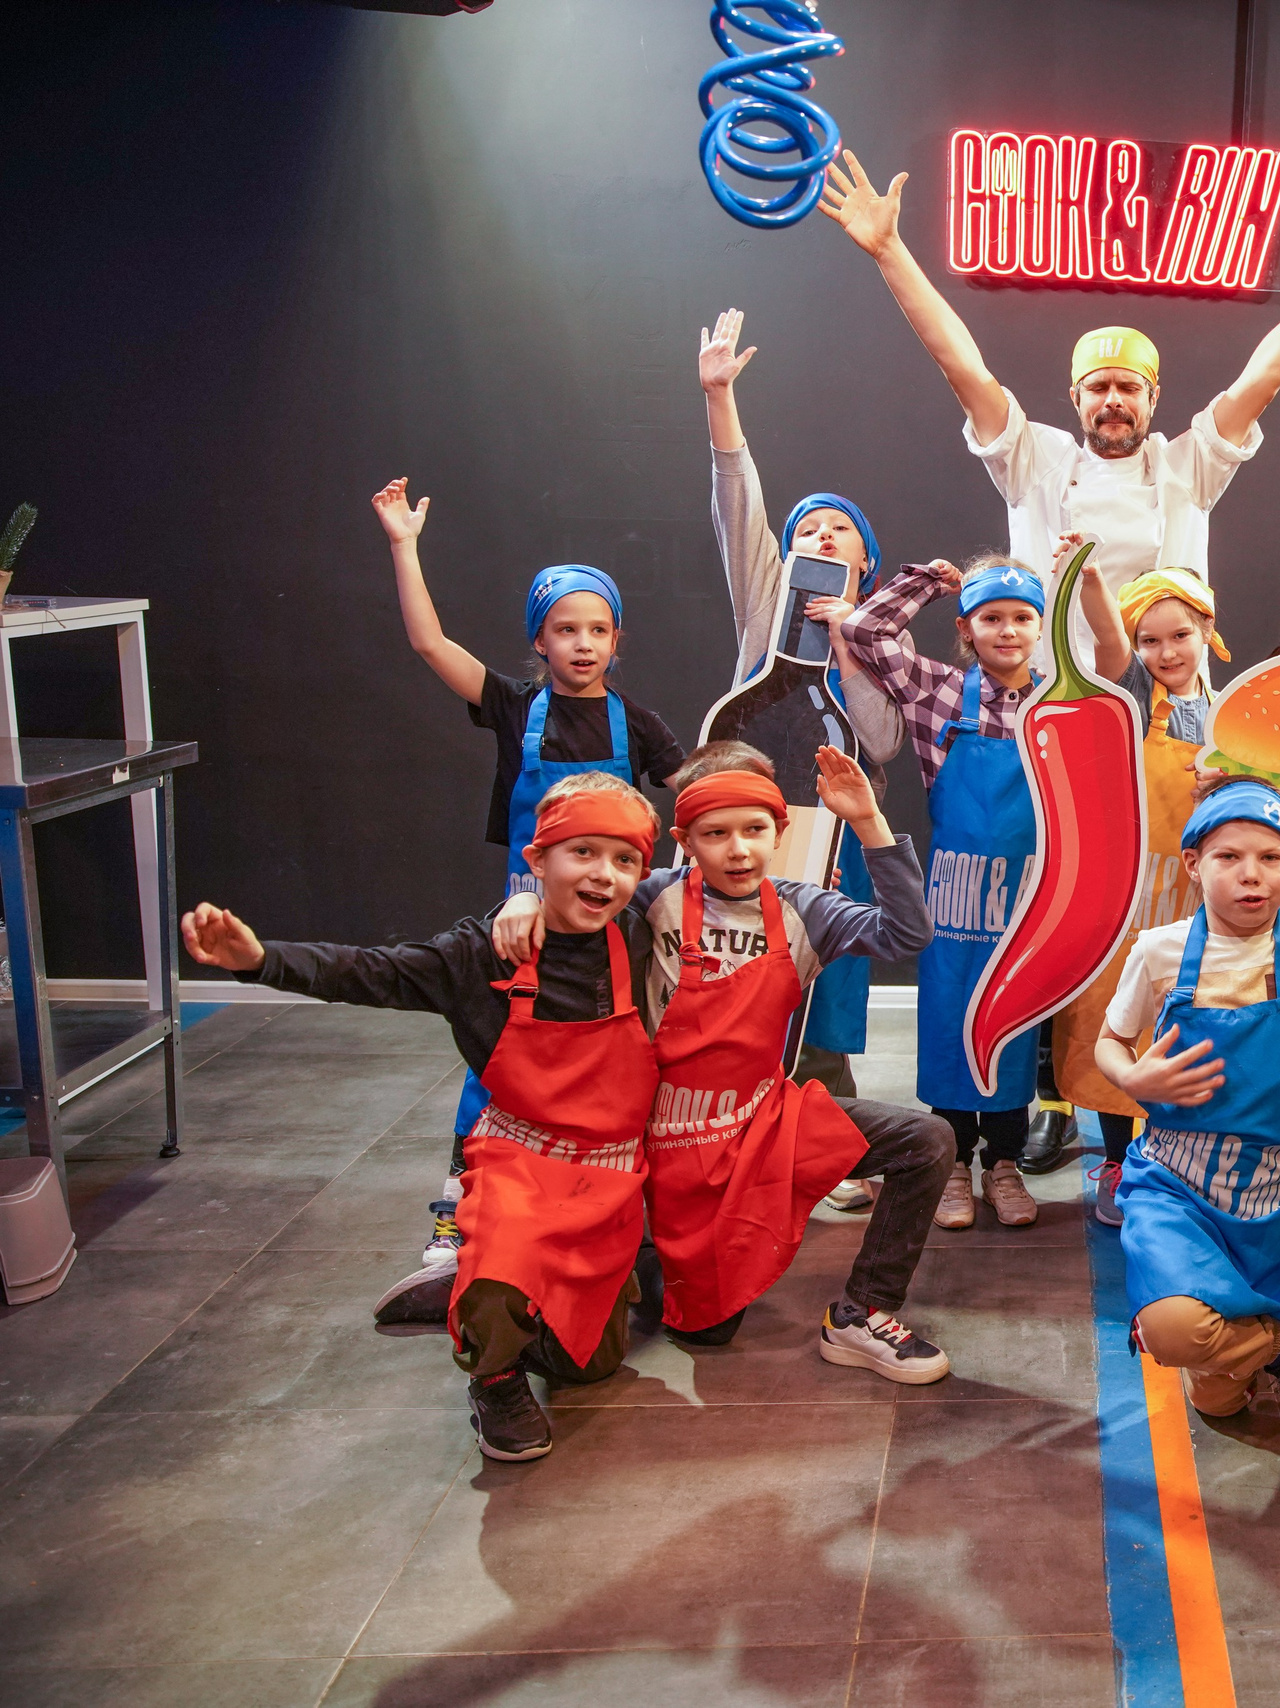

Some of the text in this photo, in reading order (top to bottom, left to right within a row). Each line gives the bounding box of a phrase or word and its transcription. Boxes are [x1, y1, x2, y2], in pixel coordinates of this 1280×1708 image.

[949, 129, 1098, 279] COOK
[1099, 139, 1152, 283] &
[927, 848, 988, 931] COOK
[661, 928, 792, 958] NTUR
[934, 928, 990, 943] линарные
